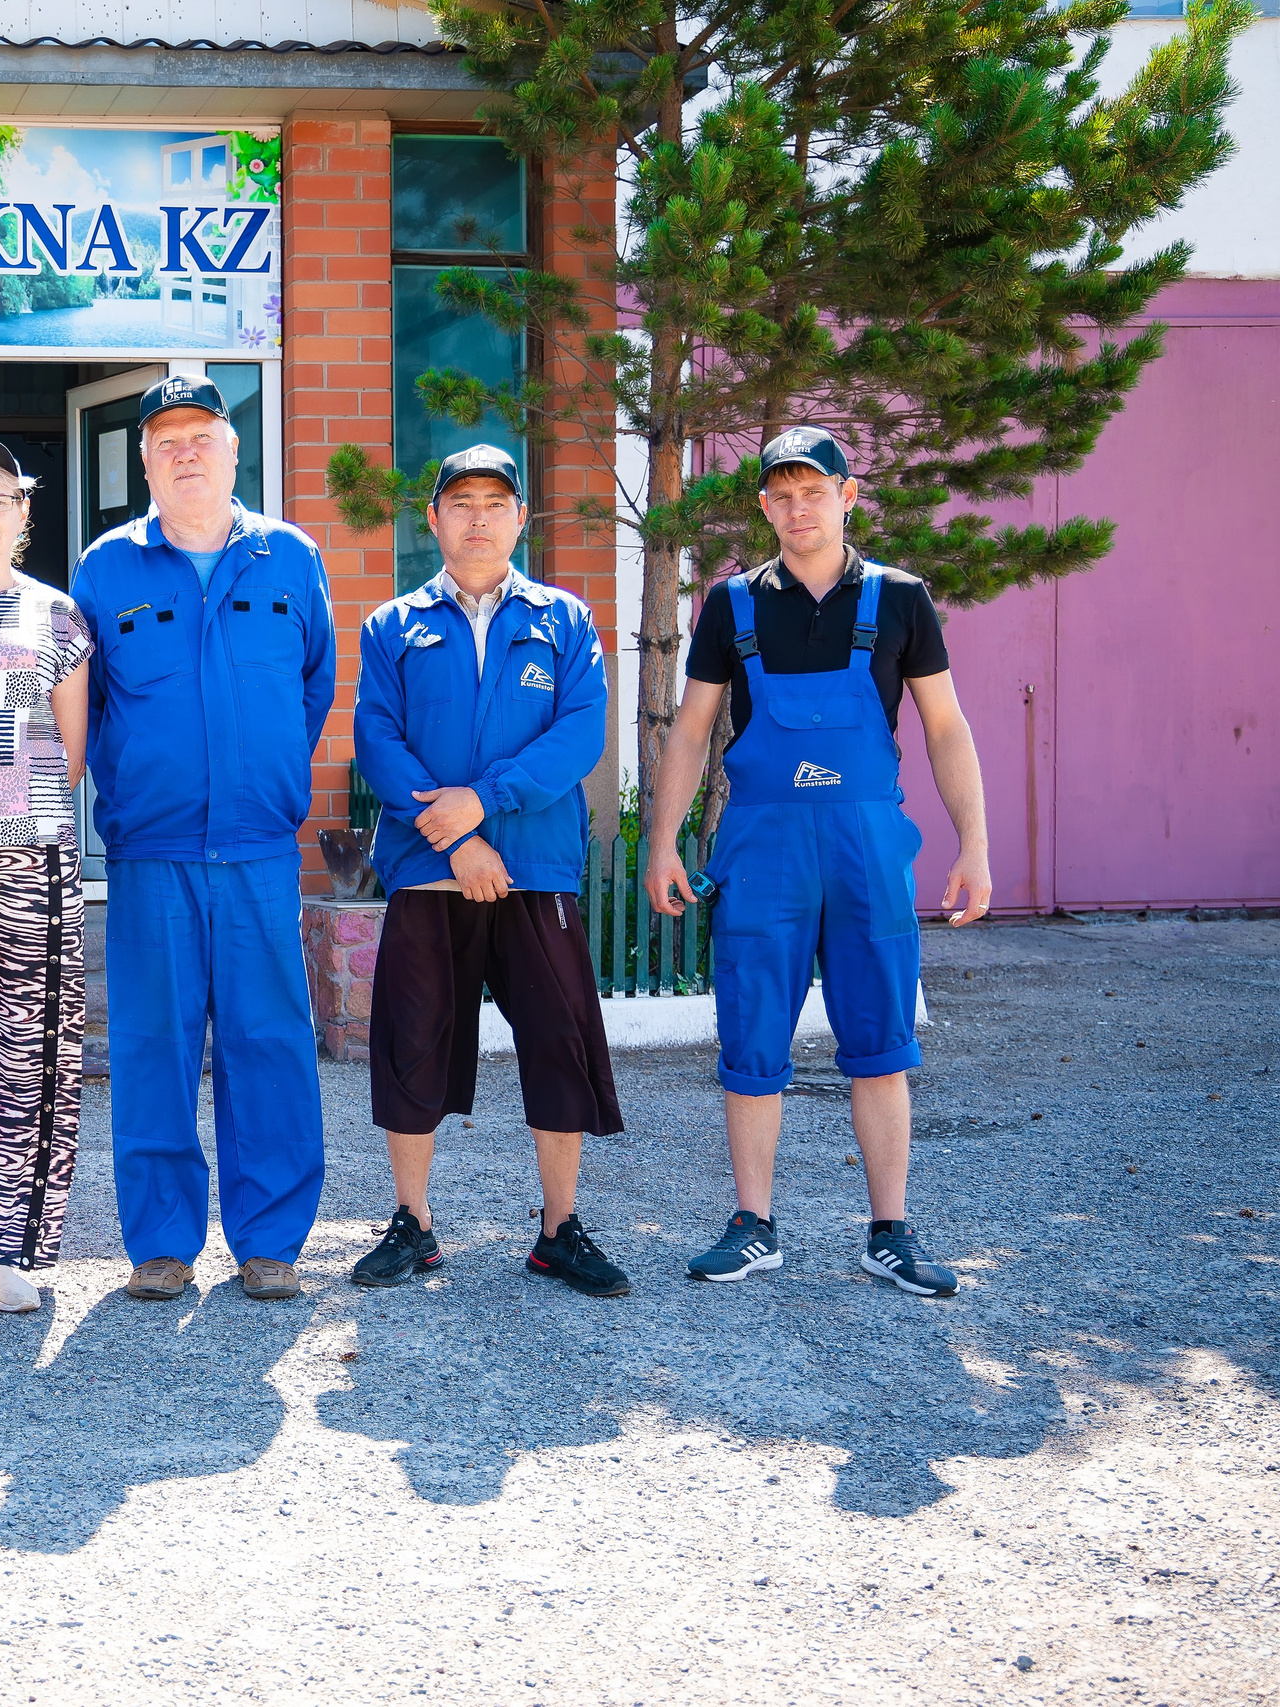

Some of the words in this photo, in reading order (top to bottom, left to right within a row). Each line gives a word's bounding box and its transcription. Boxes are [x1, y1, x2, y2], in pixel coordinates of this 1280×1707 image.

[159, 206, 271, 273] KZ
[164, 391, 193, 402] Okna
[781, 444, 811, 454] Okna
[796, 763, 828, 779] FK
[794, 779, 841, 787] Kunststoffe
